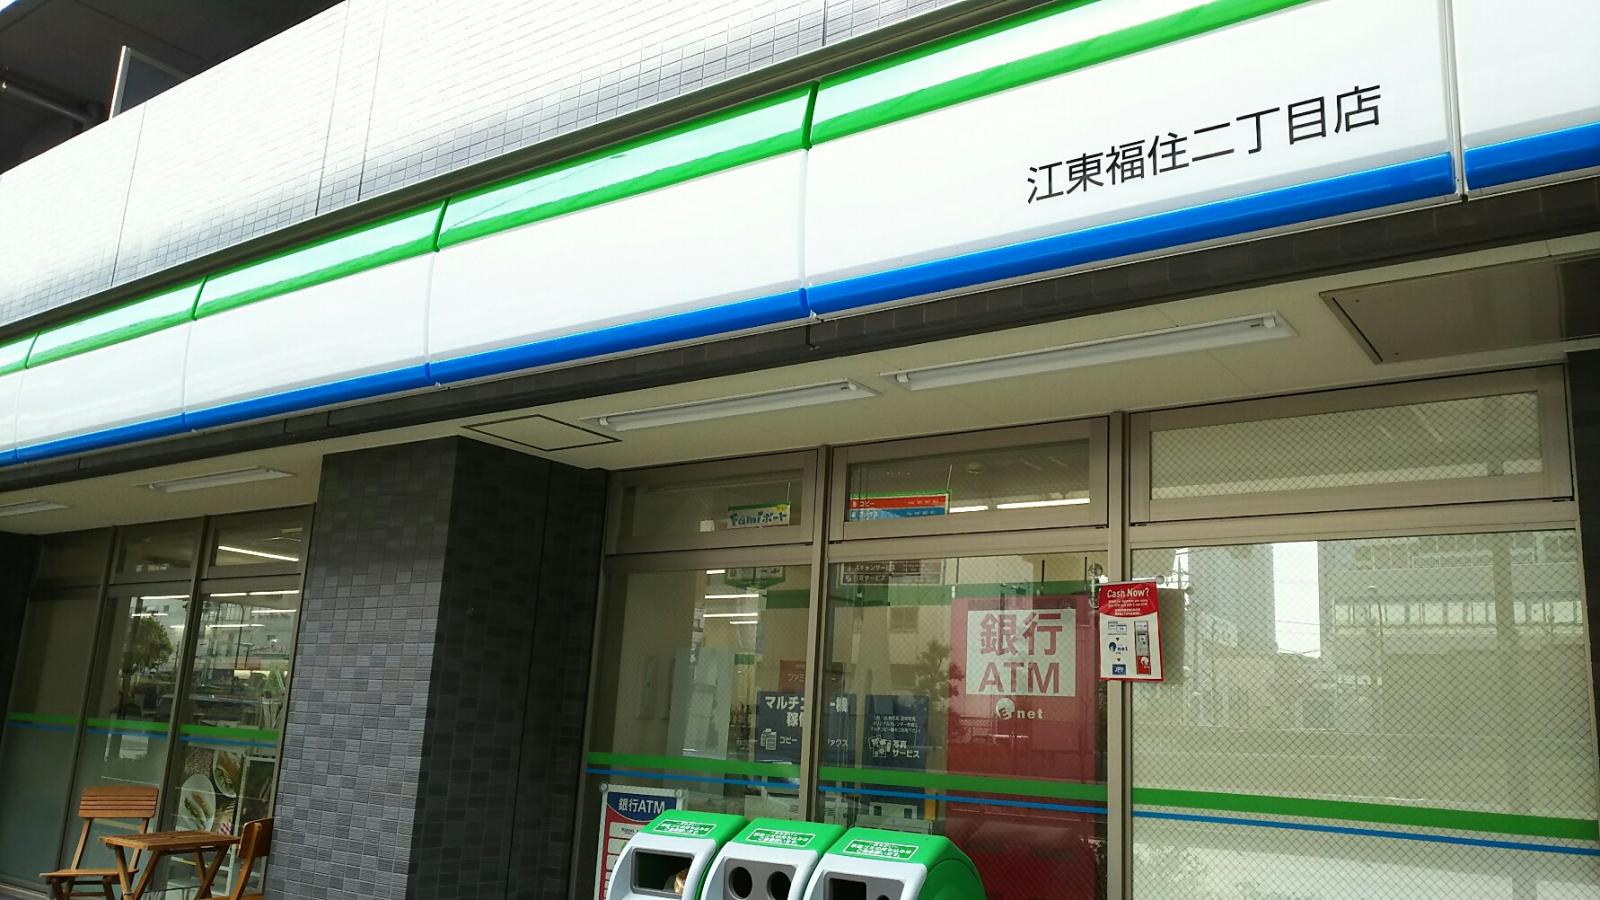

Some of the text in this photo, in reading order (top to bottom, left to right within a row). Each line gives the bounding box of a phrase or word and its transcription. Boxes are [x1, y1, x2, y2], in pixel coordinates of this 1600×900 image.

[1027, 84, 1381, 204] 江東福住二丁目店
[730, 511, 787, 527] Famiポート
[1107, 587, 1150, 598] Cash Now?
[980, 612, 1063, 656] 銀行
[978, 661, 1060, 694] ATM
[780, 737, 799, 746] コピー
[828, 738, 849, 747] ァクス
[892, 750, 920, 759] サービス
[618, 797, 666, 815] 銀行ATM
